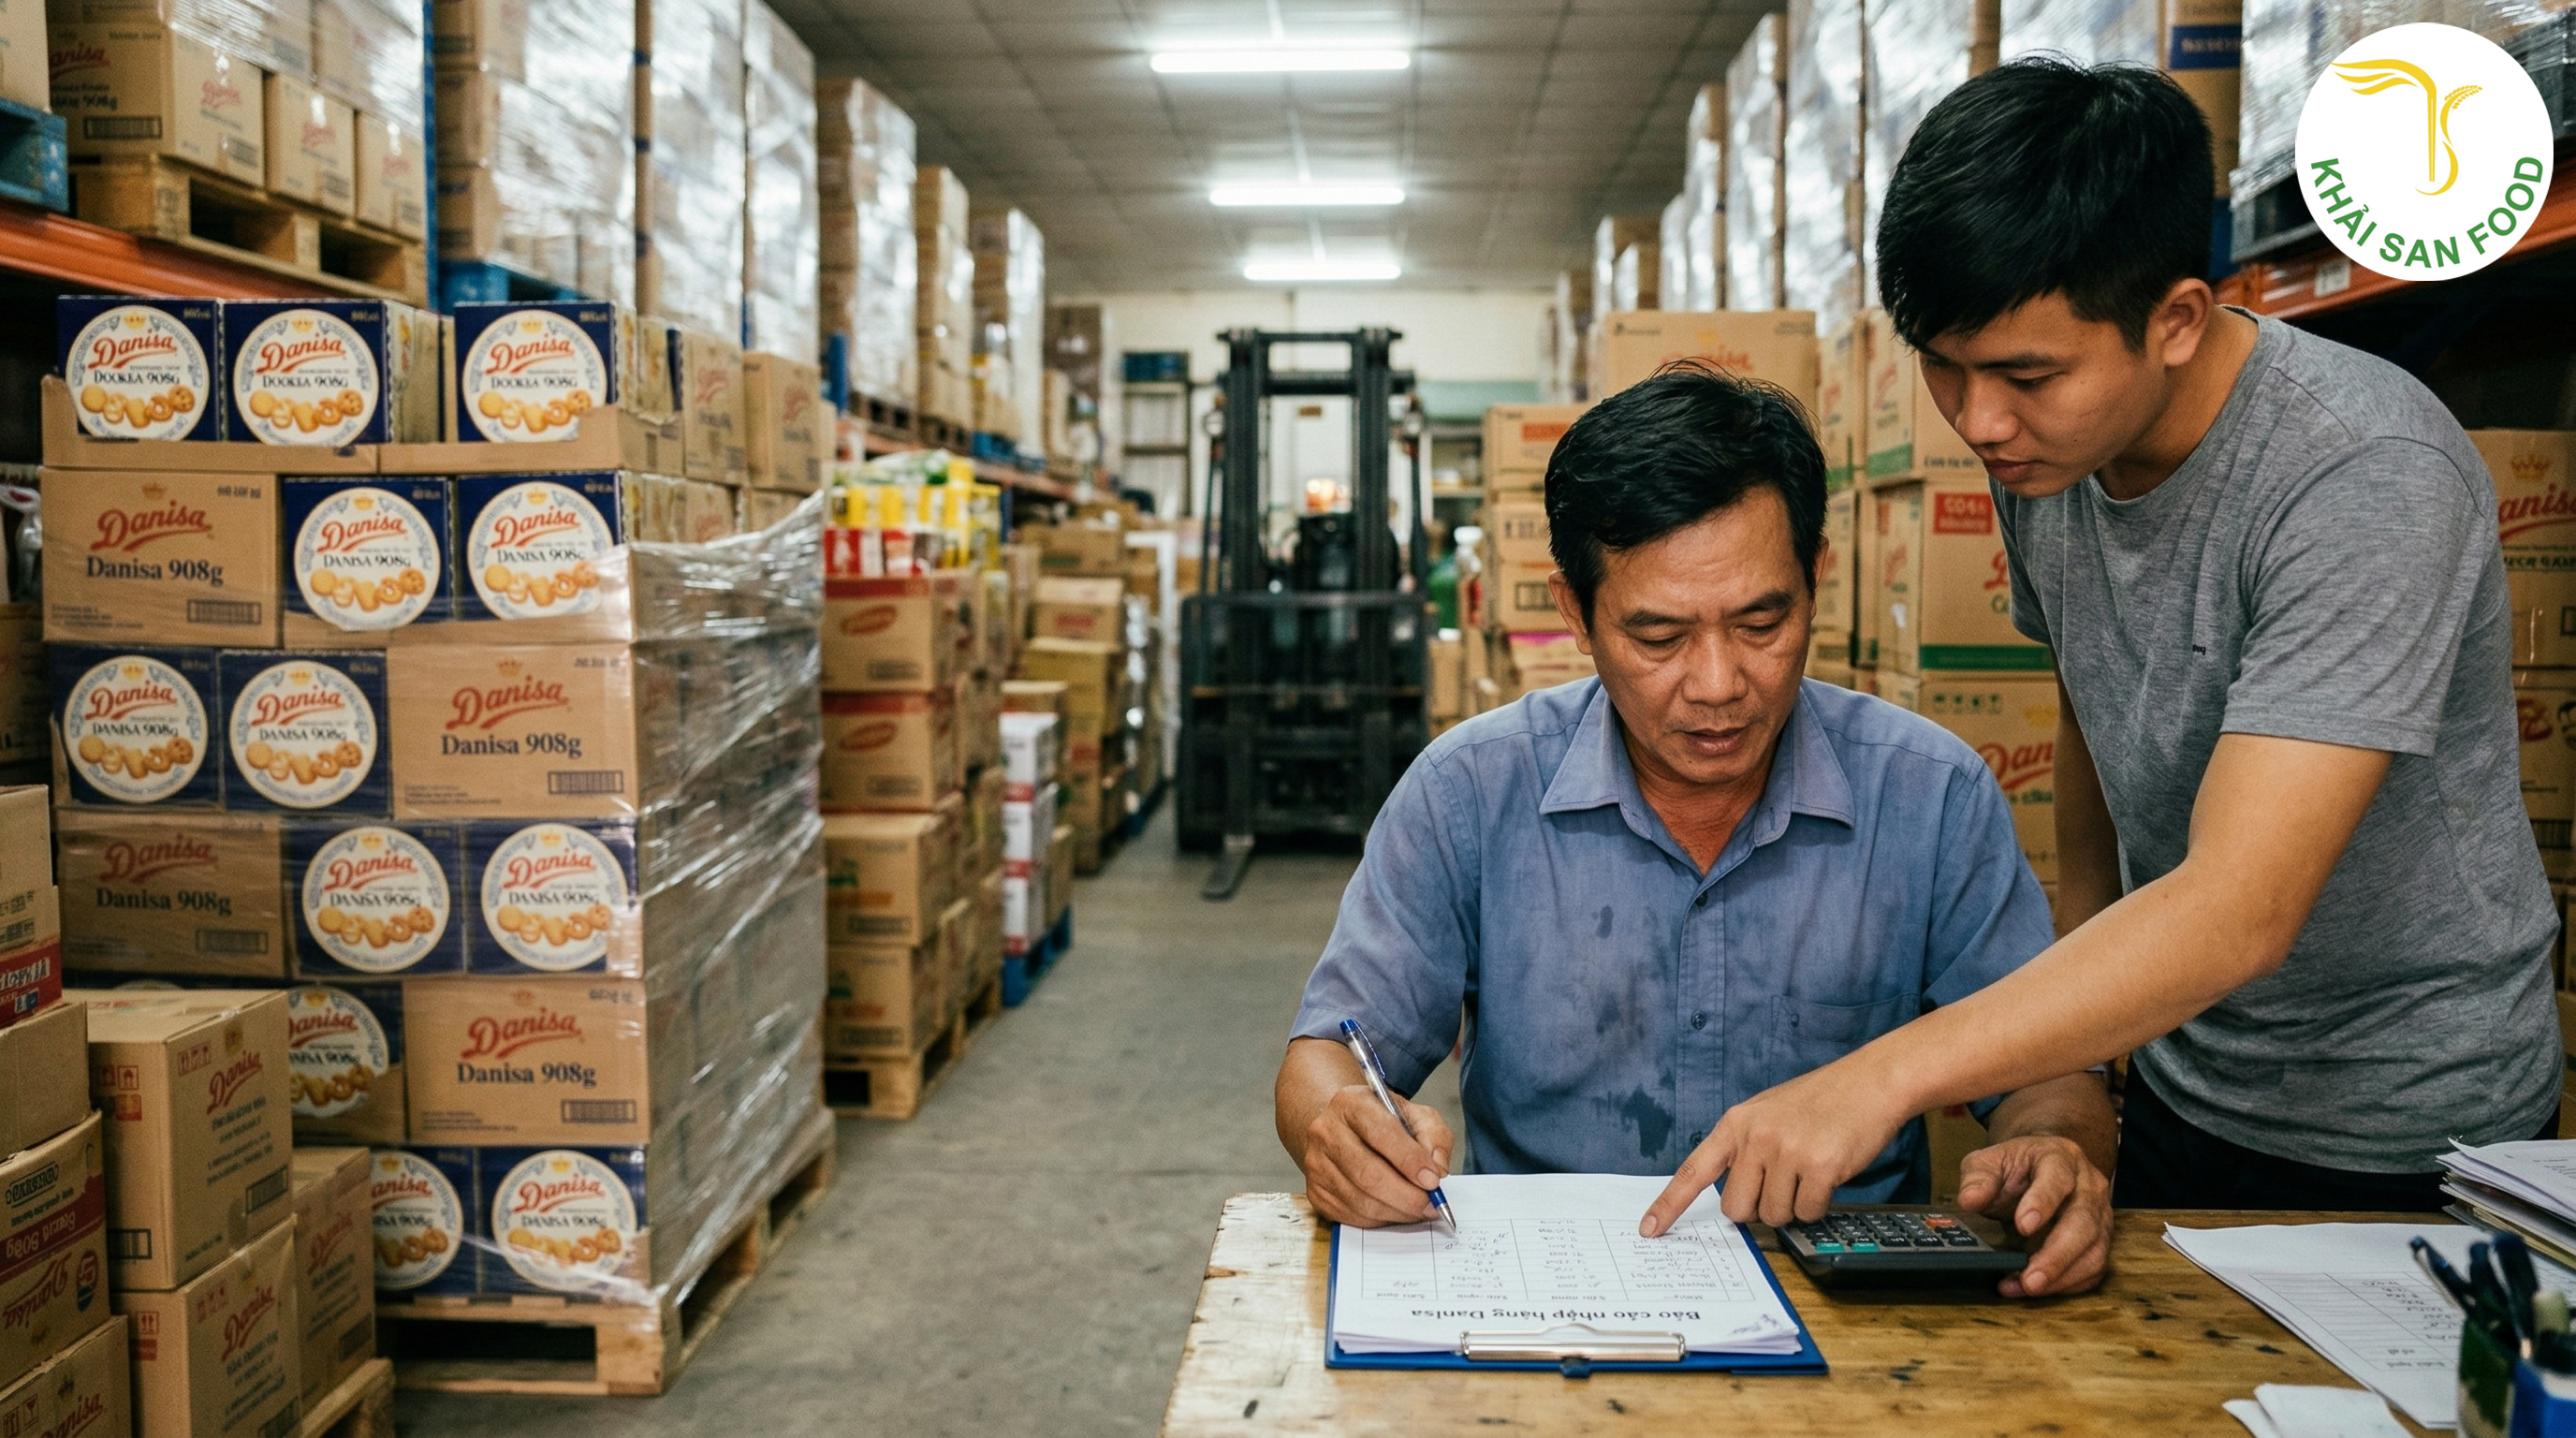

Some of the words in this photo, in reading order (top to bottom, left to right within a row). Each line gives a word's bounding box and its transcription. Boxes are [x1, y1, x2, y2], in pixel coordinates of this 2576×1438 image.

[50, 42, 110, 81] anisa
[87, 329, 178, 370] Danisa
[256, 332, 346, 374] Danisa
[485, 332, 576, 374] Danisa
[90, 499, 213, 551] Danisa
[316, 510, 408, 553] Danisa
[490, 506, 581, 549] Danisa
[2498, 482, 2576, 541] anis
[86, 555, 163, 580] Danisa
[168, 558, 224, 587] 908g
[84, 679, 178, 721] Danisa
[251, 684, 345, 726] Danisa
[446, 674, 570, 730] Danisa
[441, 733, 520, 756] Danisa
[525, 733, 582, 759] 908g
[99, 833, 218, 885] Danisa
[324, 849, 417, 892] Danisa
[503, 847, 597, 889] Danisa
[96, 888, 171, 910] Danisa
[178, 890, 232, 917] 908g
[460, 1006, 582, 1060] Danisa
[206, 1049, 263, 1115] Danisa
[456, 1062, 534, 1084] Danisa
[541, 1062, 597, 1087] 908g
[373, 1173, 432, 1211] anisa
[512, 1173, 605, 1213] Danisa
[2, 1252, 73, 1330] Danisa
[221, 1284, 275, 1363] Danisa
[40, 1393, 104, 1438] anisa
